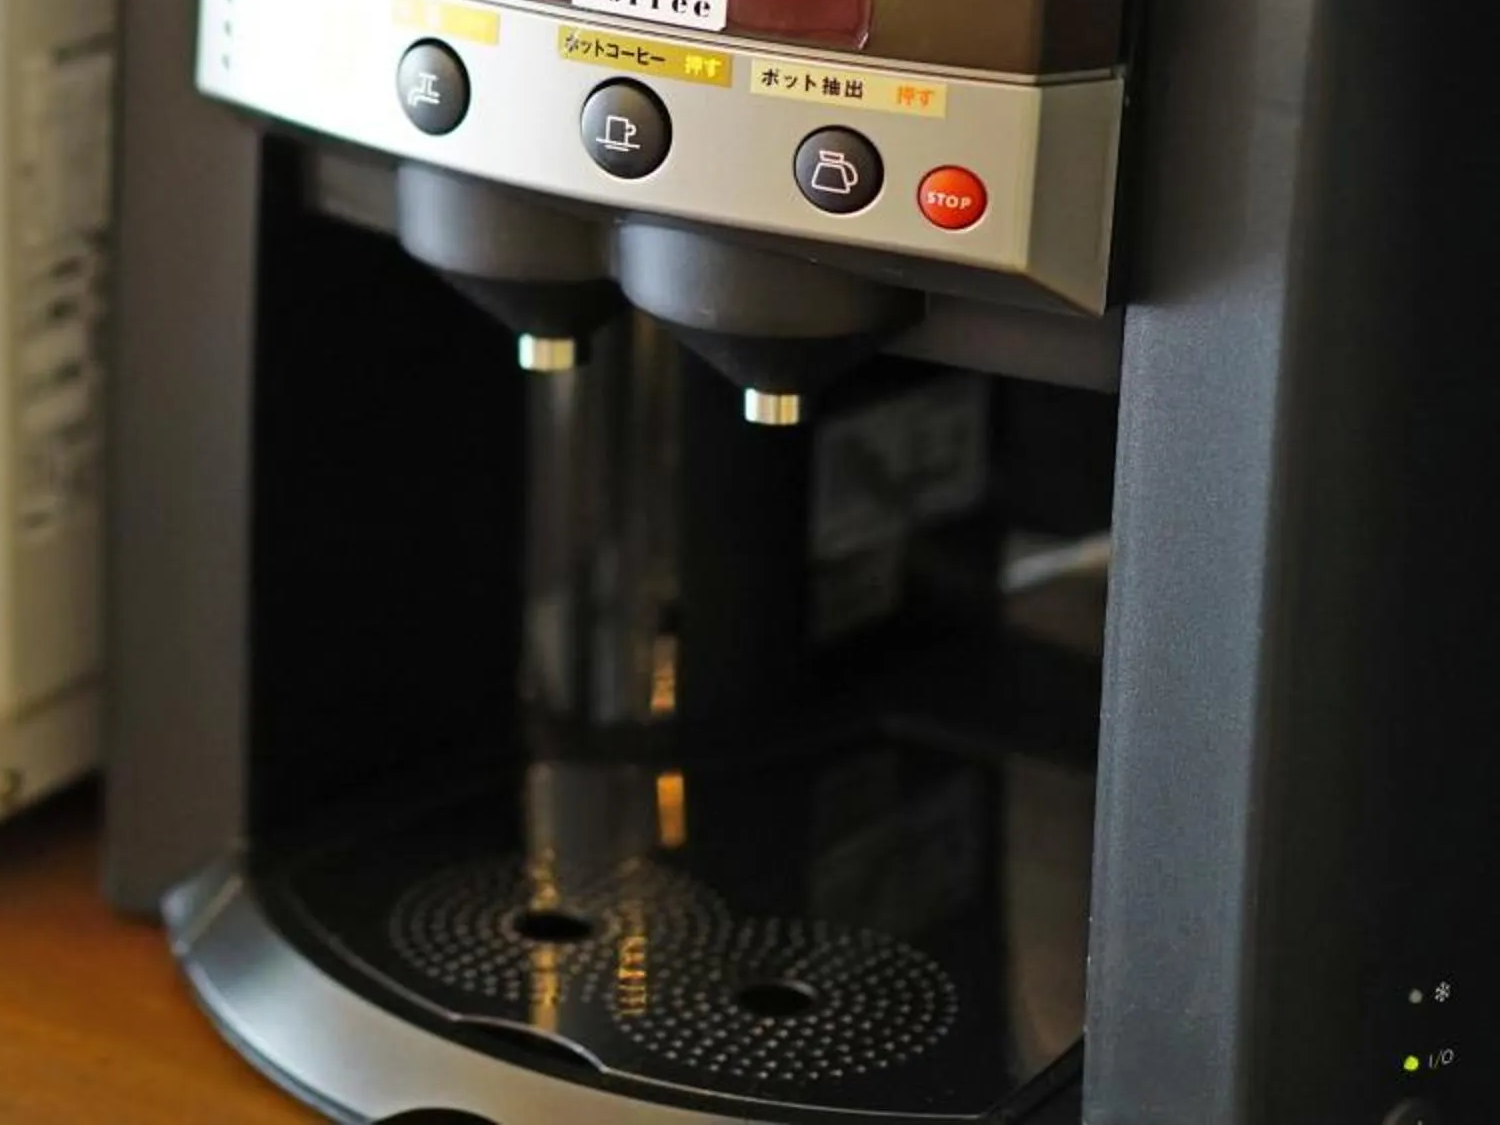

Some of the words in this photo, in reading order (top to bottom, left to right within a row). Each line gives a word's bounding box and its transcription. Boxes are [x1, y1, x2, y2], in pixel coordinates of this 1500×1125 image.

[684, 54, 722, 78] 押す
[896, 84, 935, 108] 押す
[926, 190, 972, 211] STOP
